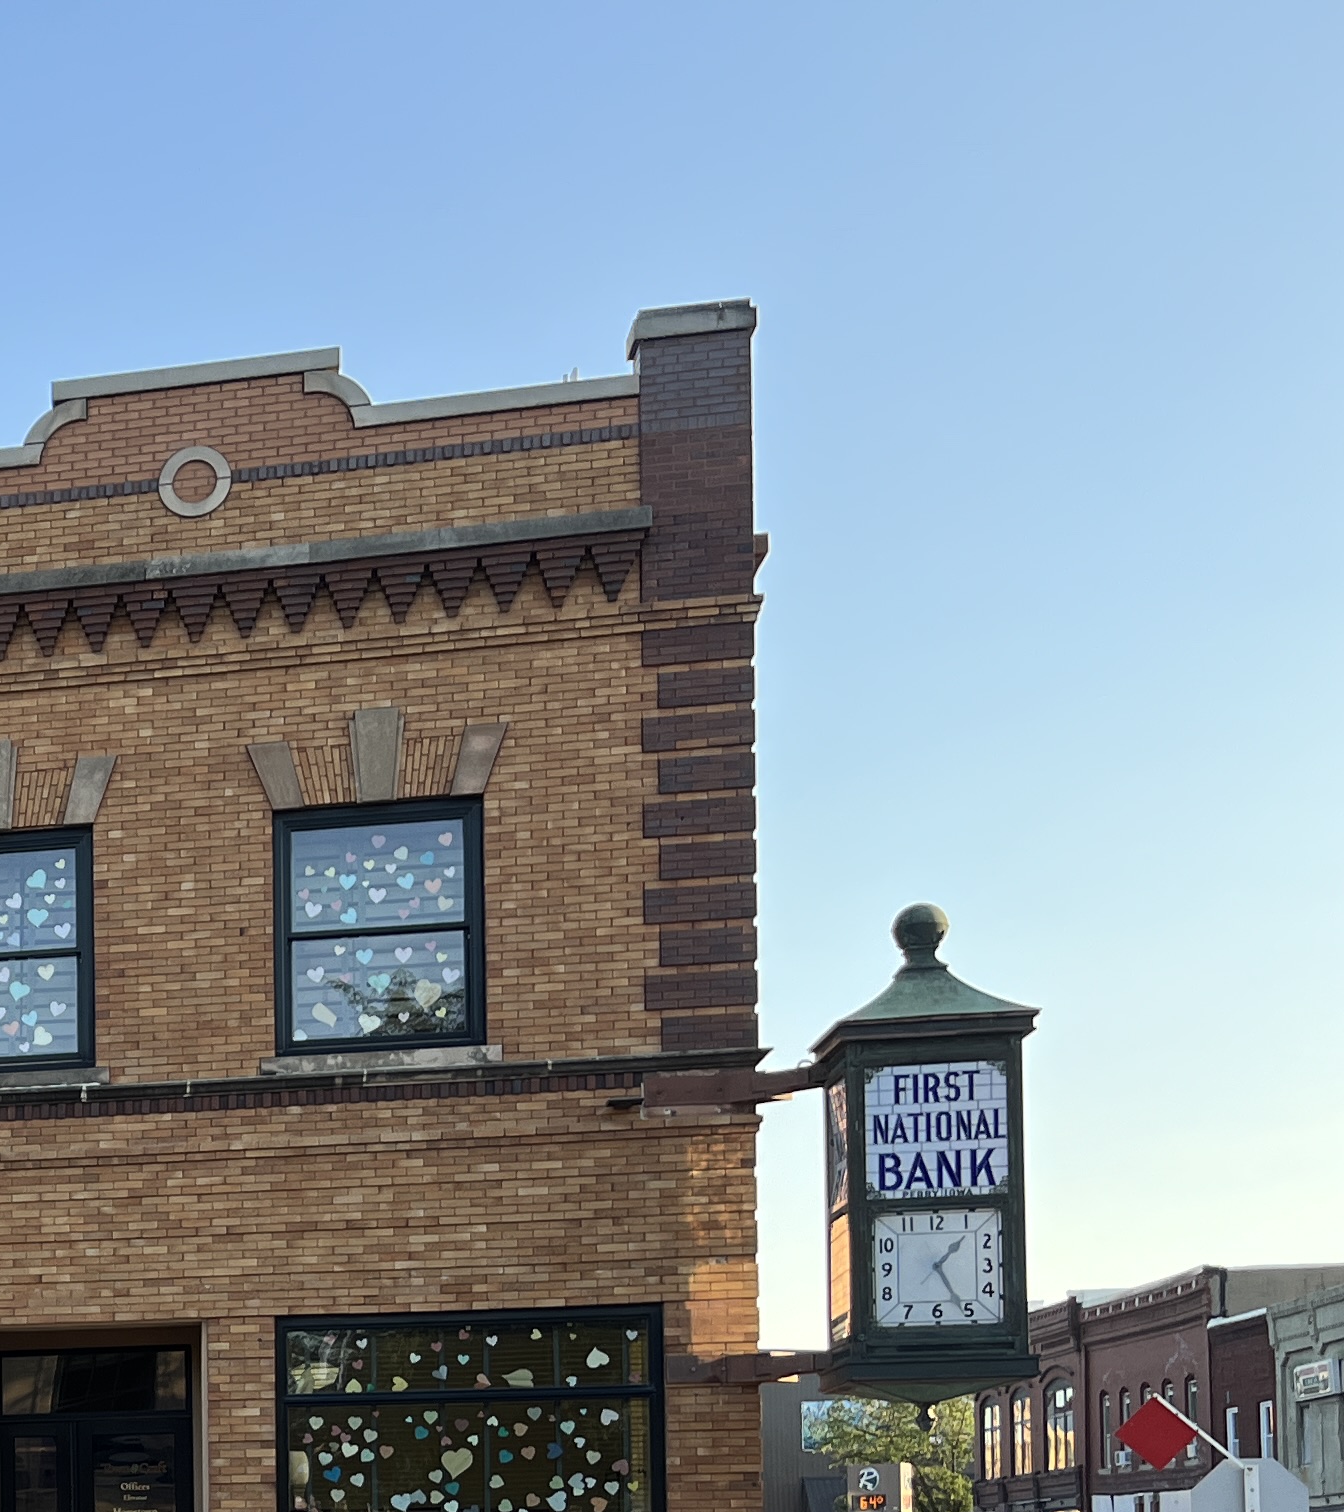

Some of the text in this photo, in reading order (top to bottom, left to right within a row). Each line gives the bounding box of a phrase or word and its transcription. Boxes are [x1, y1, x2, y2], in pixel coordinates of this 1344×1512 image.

[894, 1070, 980, 1105] FIRST
[873, 1108, 1007, 1145] NATIONAL
[878, 1148, 996, 1191] BANK
[902, 1216, 914, 1232] 11
[930, 1215, 944, 1231] 12
[879, 1237, 894, 1254] 10
[982, 1233, 992, 1249] 2
[881, 1262, 893, 1278] 9
[982, 1257, 993, 1273] 3
[881, 1286, 893, 1301] 8
[981, 1282, 995, 1298] 4
[903, 1302, 975, 1320] 7 6 5
[120, 1482, 151, 1491] Offices
